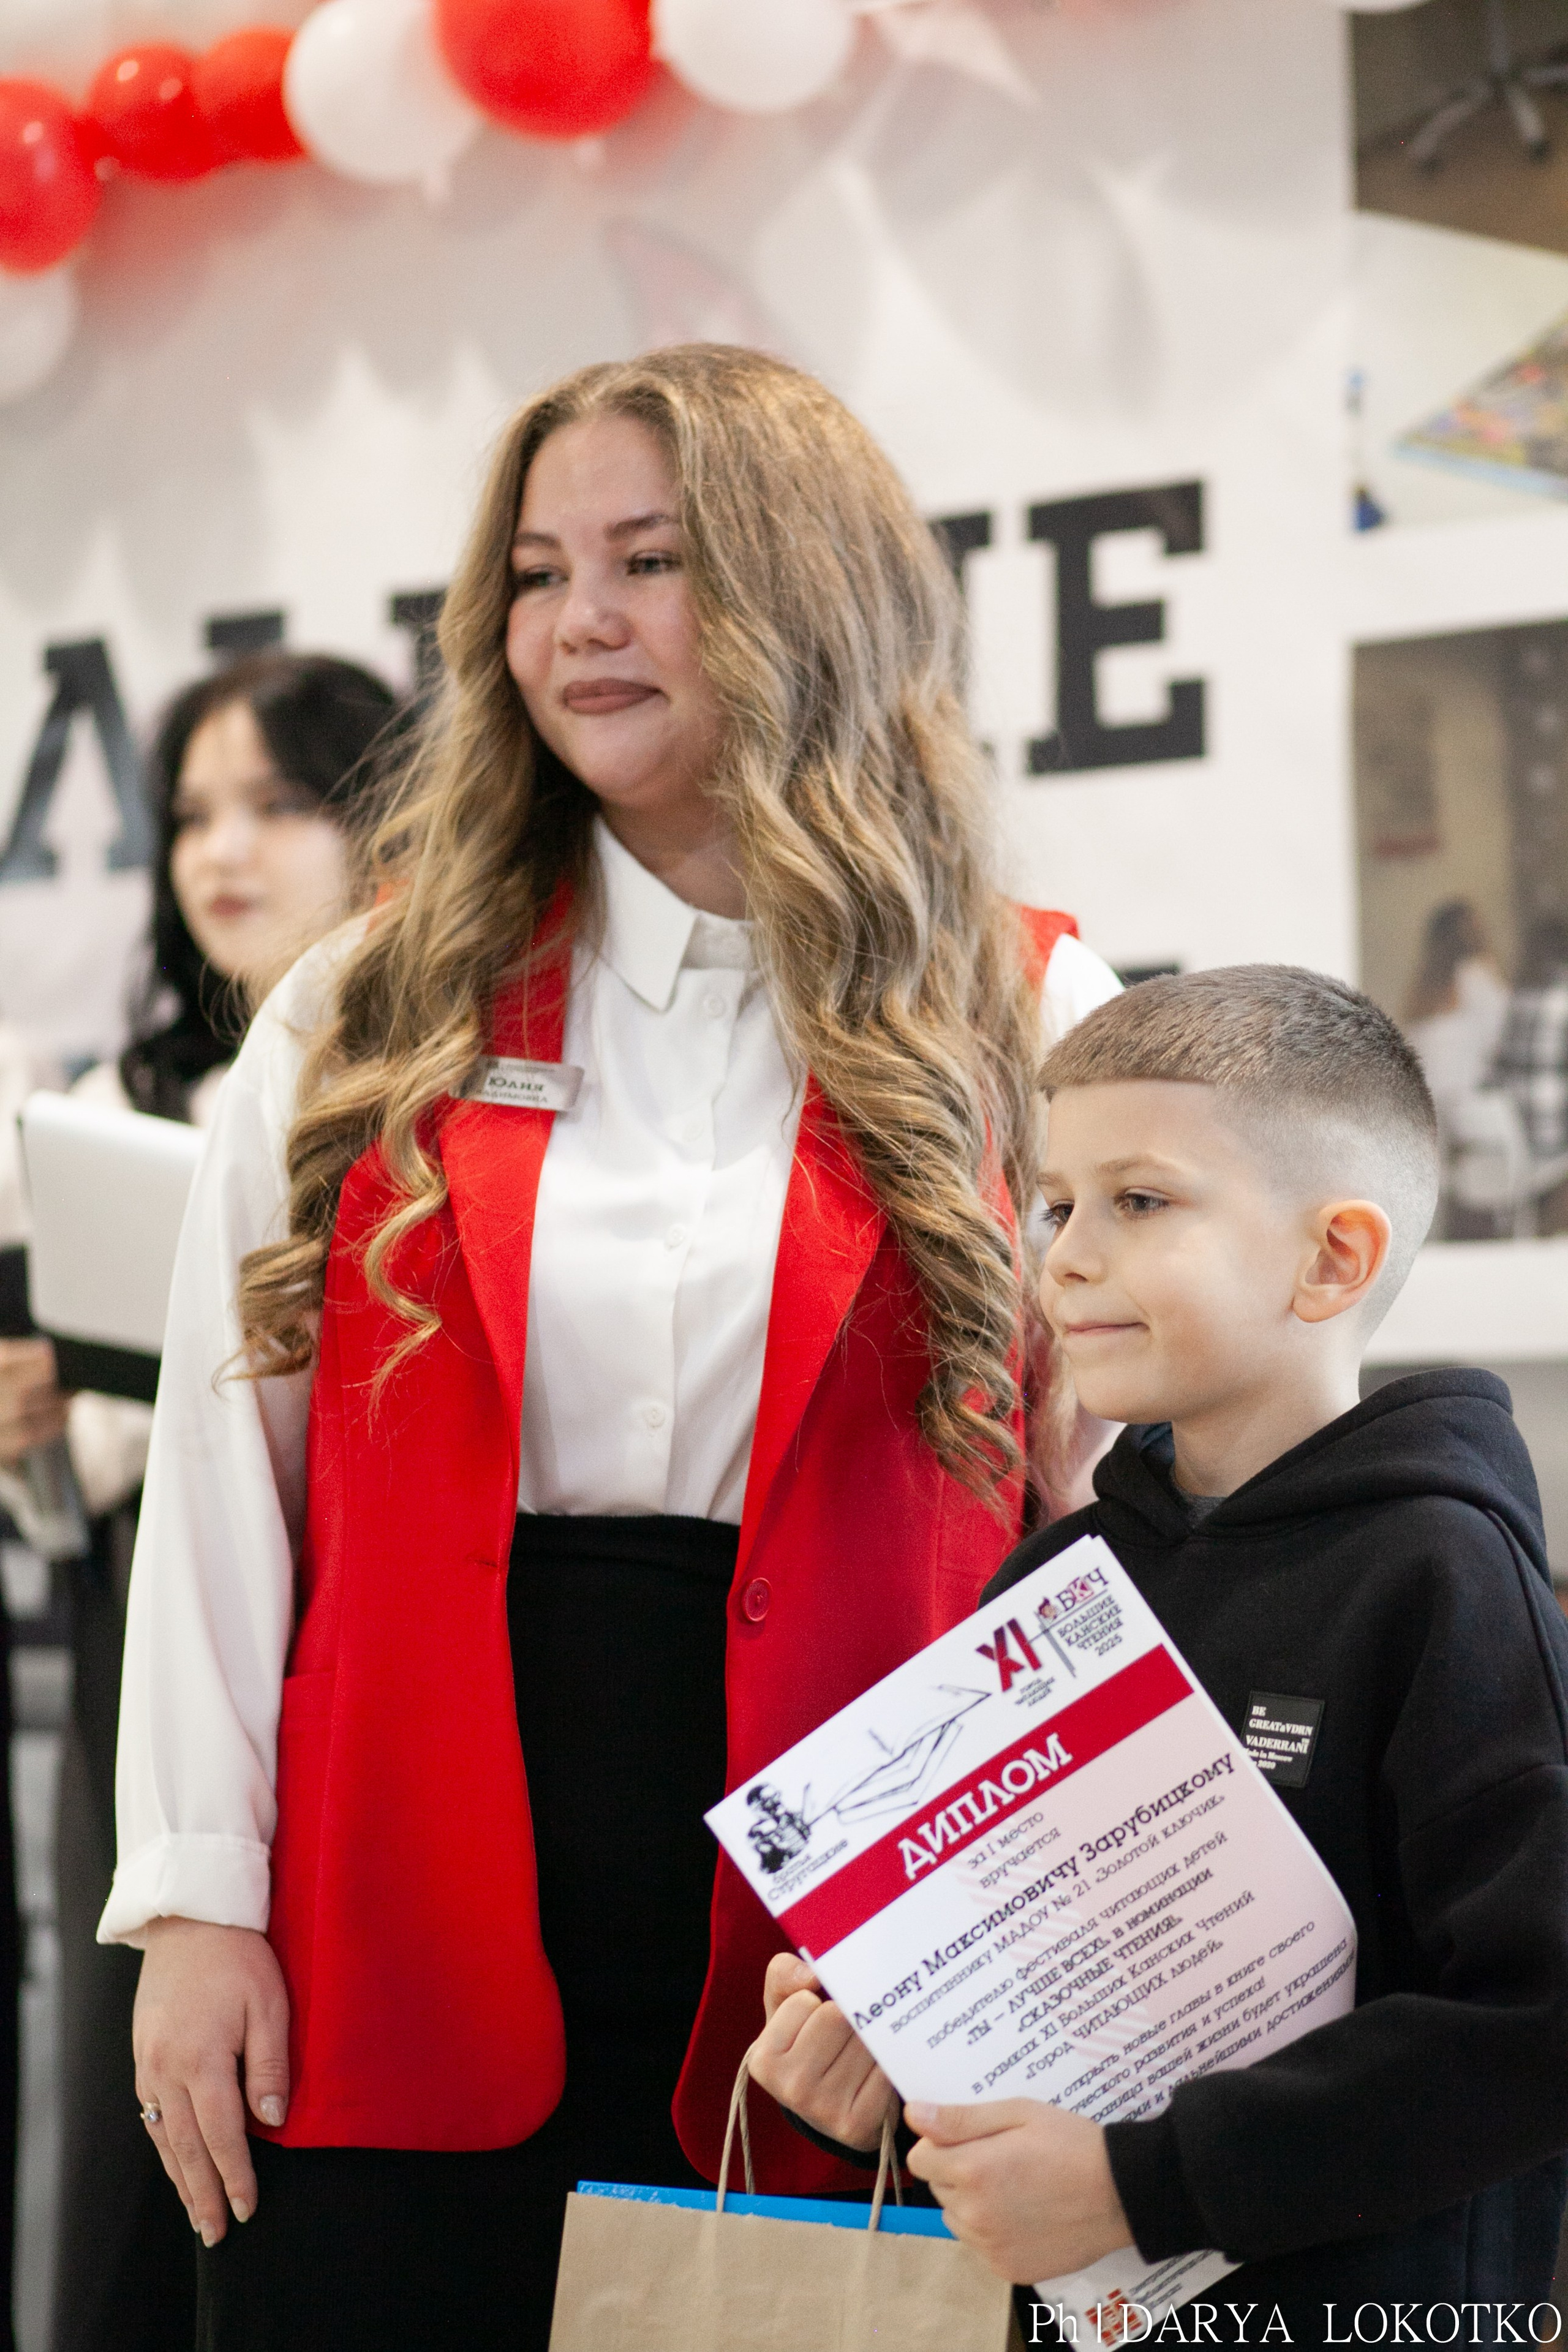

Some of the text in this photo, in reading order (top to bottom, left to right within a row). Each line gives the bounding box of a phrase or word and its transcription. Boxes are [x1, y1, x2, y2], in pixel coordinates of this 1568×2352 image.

[975, 1618, 1042, 1693] XI
[1057, 1594, 1115, 1638] БОЛЬШИЕ
[1065, 1604, 1121, 1646] КАНСКИЕ
[1077, 1618, 1123, 1649] ЧТЕНИЯ
[1095, 1634, 1122, 1656] 2025
[1252, 1706, 1267, 1716] BE
[898, 1732, 1072, 1881] ДИПЛОМ
[968, 1852, 987, 1870] за
[999, 1812, 1043, 1849] место
[853, 1754, 1235, 2029] Леону Максимовичу Зарубицкому
[979, 1826, 1060, 1889] вручается
[890, 1950, 993, 2033] воспитаннику
[993, 1905, 1049, 1953] МАДОУ
[1051, 1895, 1071, 1912] №
[1073, 1880, 1091, 1898] 21
[927, 1831, 1228, 2048] победителю фестиваля читающих детей
[1008, 1967, 1062, 2014] ЛУЧШЕ
[1113, 1926, 1124, 1939] в
[1125, 1867, 1213, 1931] номинации
[972, 1890, 1254, 2094] в рамках XI Больших Канских Чтений
[1065, 1921, 1314, 2097] открыть новые главы в книге своего
[1072, 1972, 1167, 2040] ЧИТАЮЩИХ
[1091, 2082, 1143, 2123] раница
[1147, 2047, 1193, 2086] вашей
[1197, 2018, 1240, 2053] жизни
[1243, 1991, 1281, 2022] будет
[1284, 1937, 1347, 1997] украшена
[1134, 2023, 1197, 2074] развития
[1202, 2014, 1212, 2027] и
[1214, 1975, 1265, 2019] успеха!
